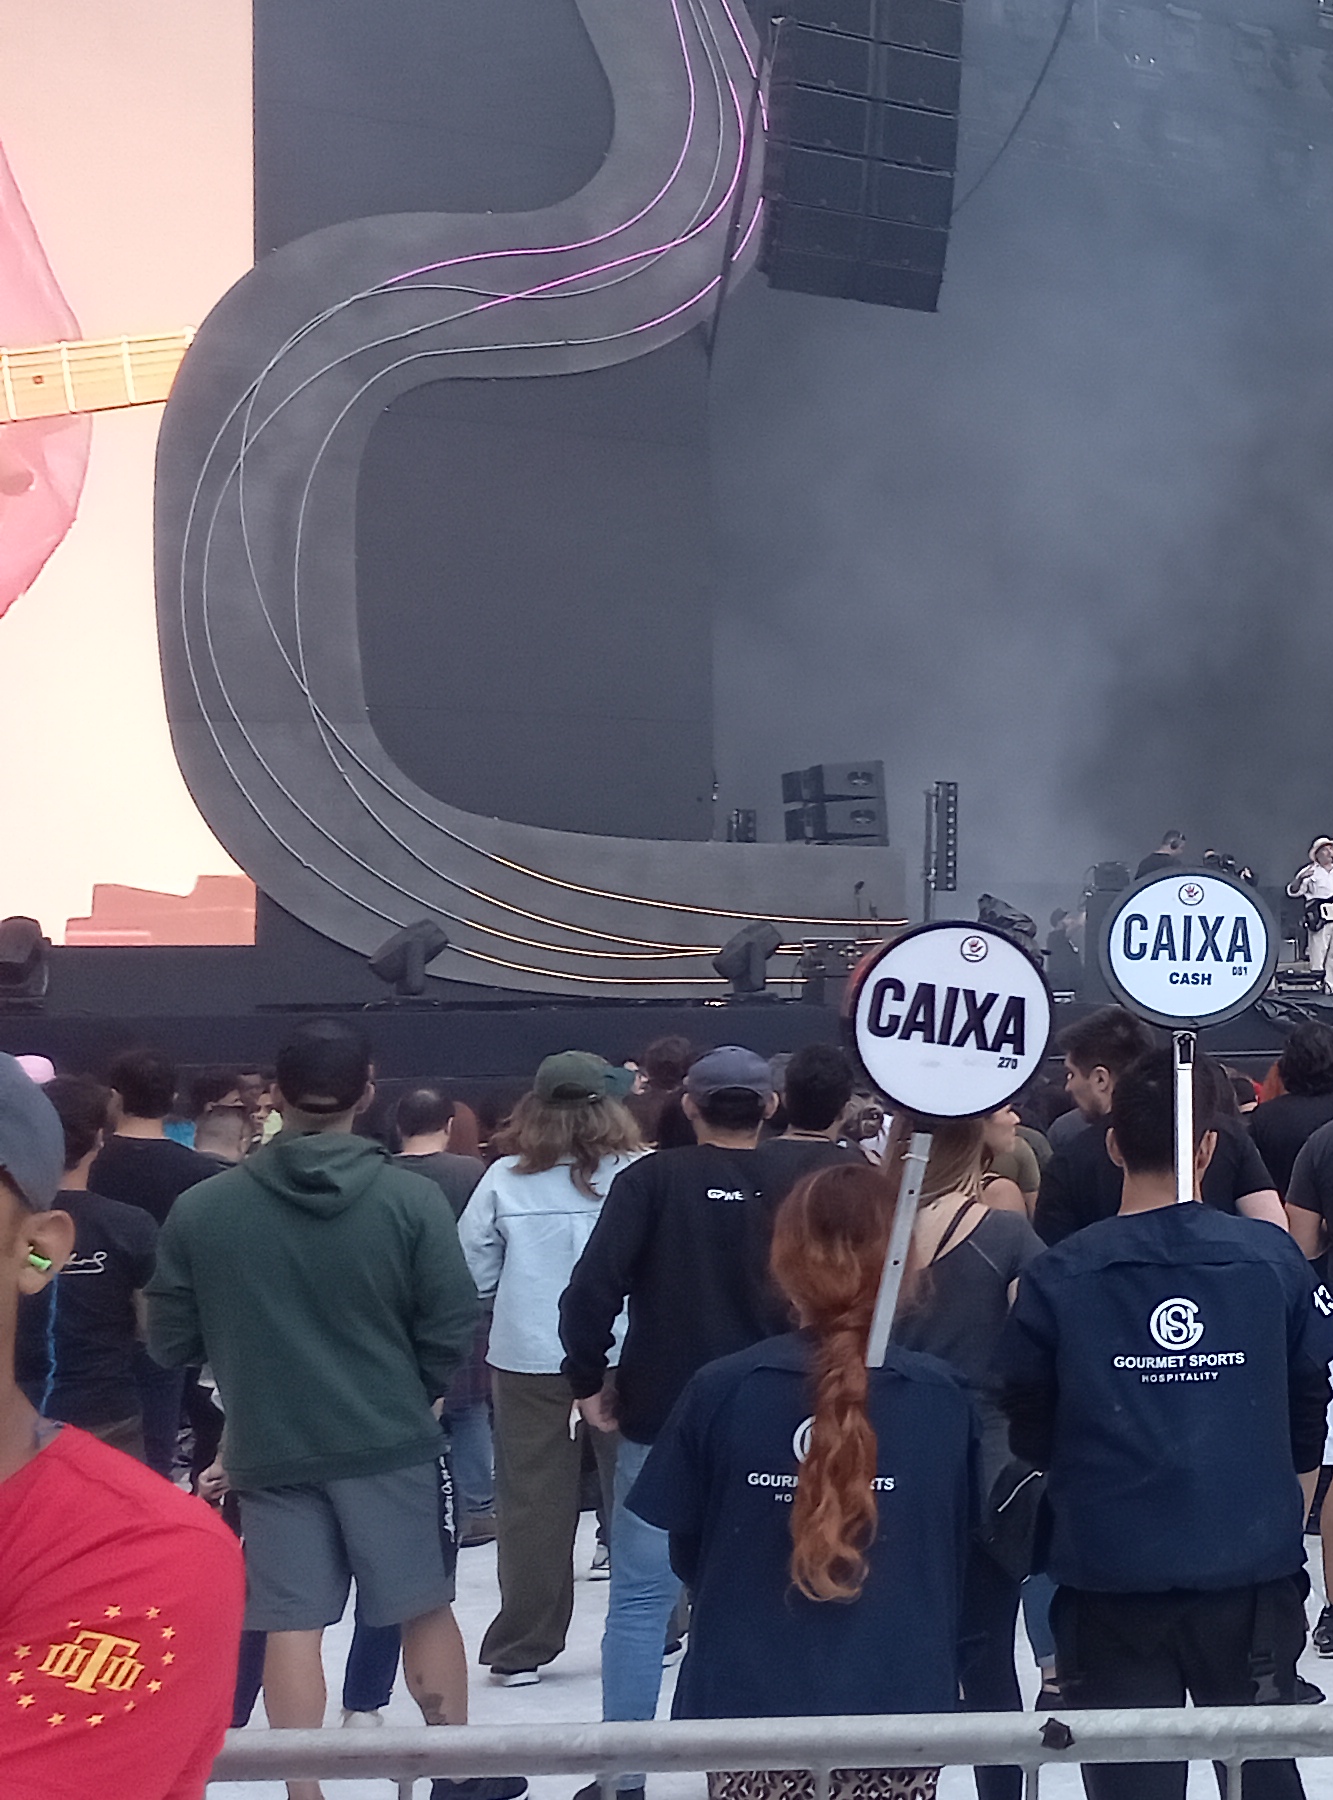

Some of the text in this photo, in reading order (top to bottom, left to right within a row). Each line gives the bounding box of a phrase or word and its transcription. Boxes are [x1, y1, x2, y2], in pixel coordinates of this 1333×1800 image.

[1123, 913, 1253, 963] CAIXA
[1169, 971, 1212, 985] CASH
[867, 977, 1026, 1056] CAIXA
[997, 1056, 1018, 1070] 270
[707, 1188, 762, 1201] GPWE
[1114, 1352, 1245, 1369] GOURMET SPORTS
[1141, 1371, 1219, 1383] HOSPITALITY
[747, 1472, 799, 1488] GOUR
